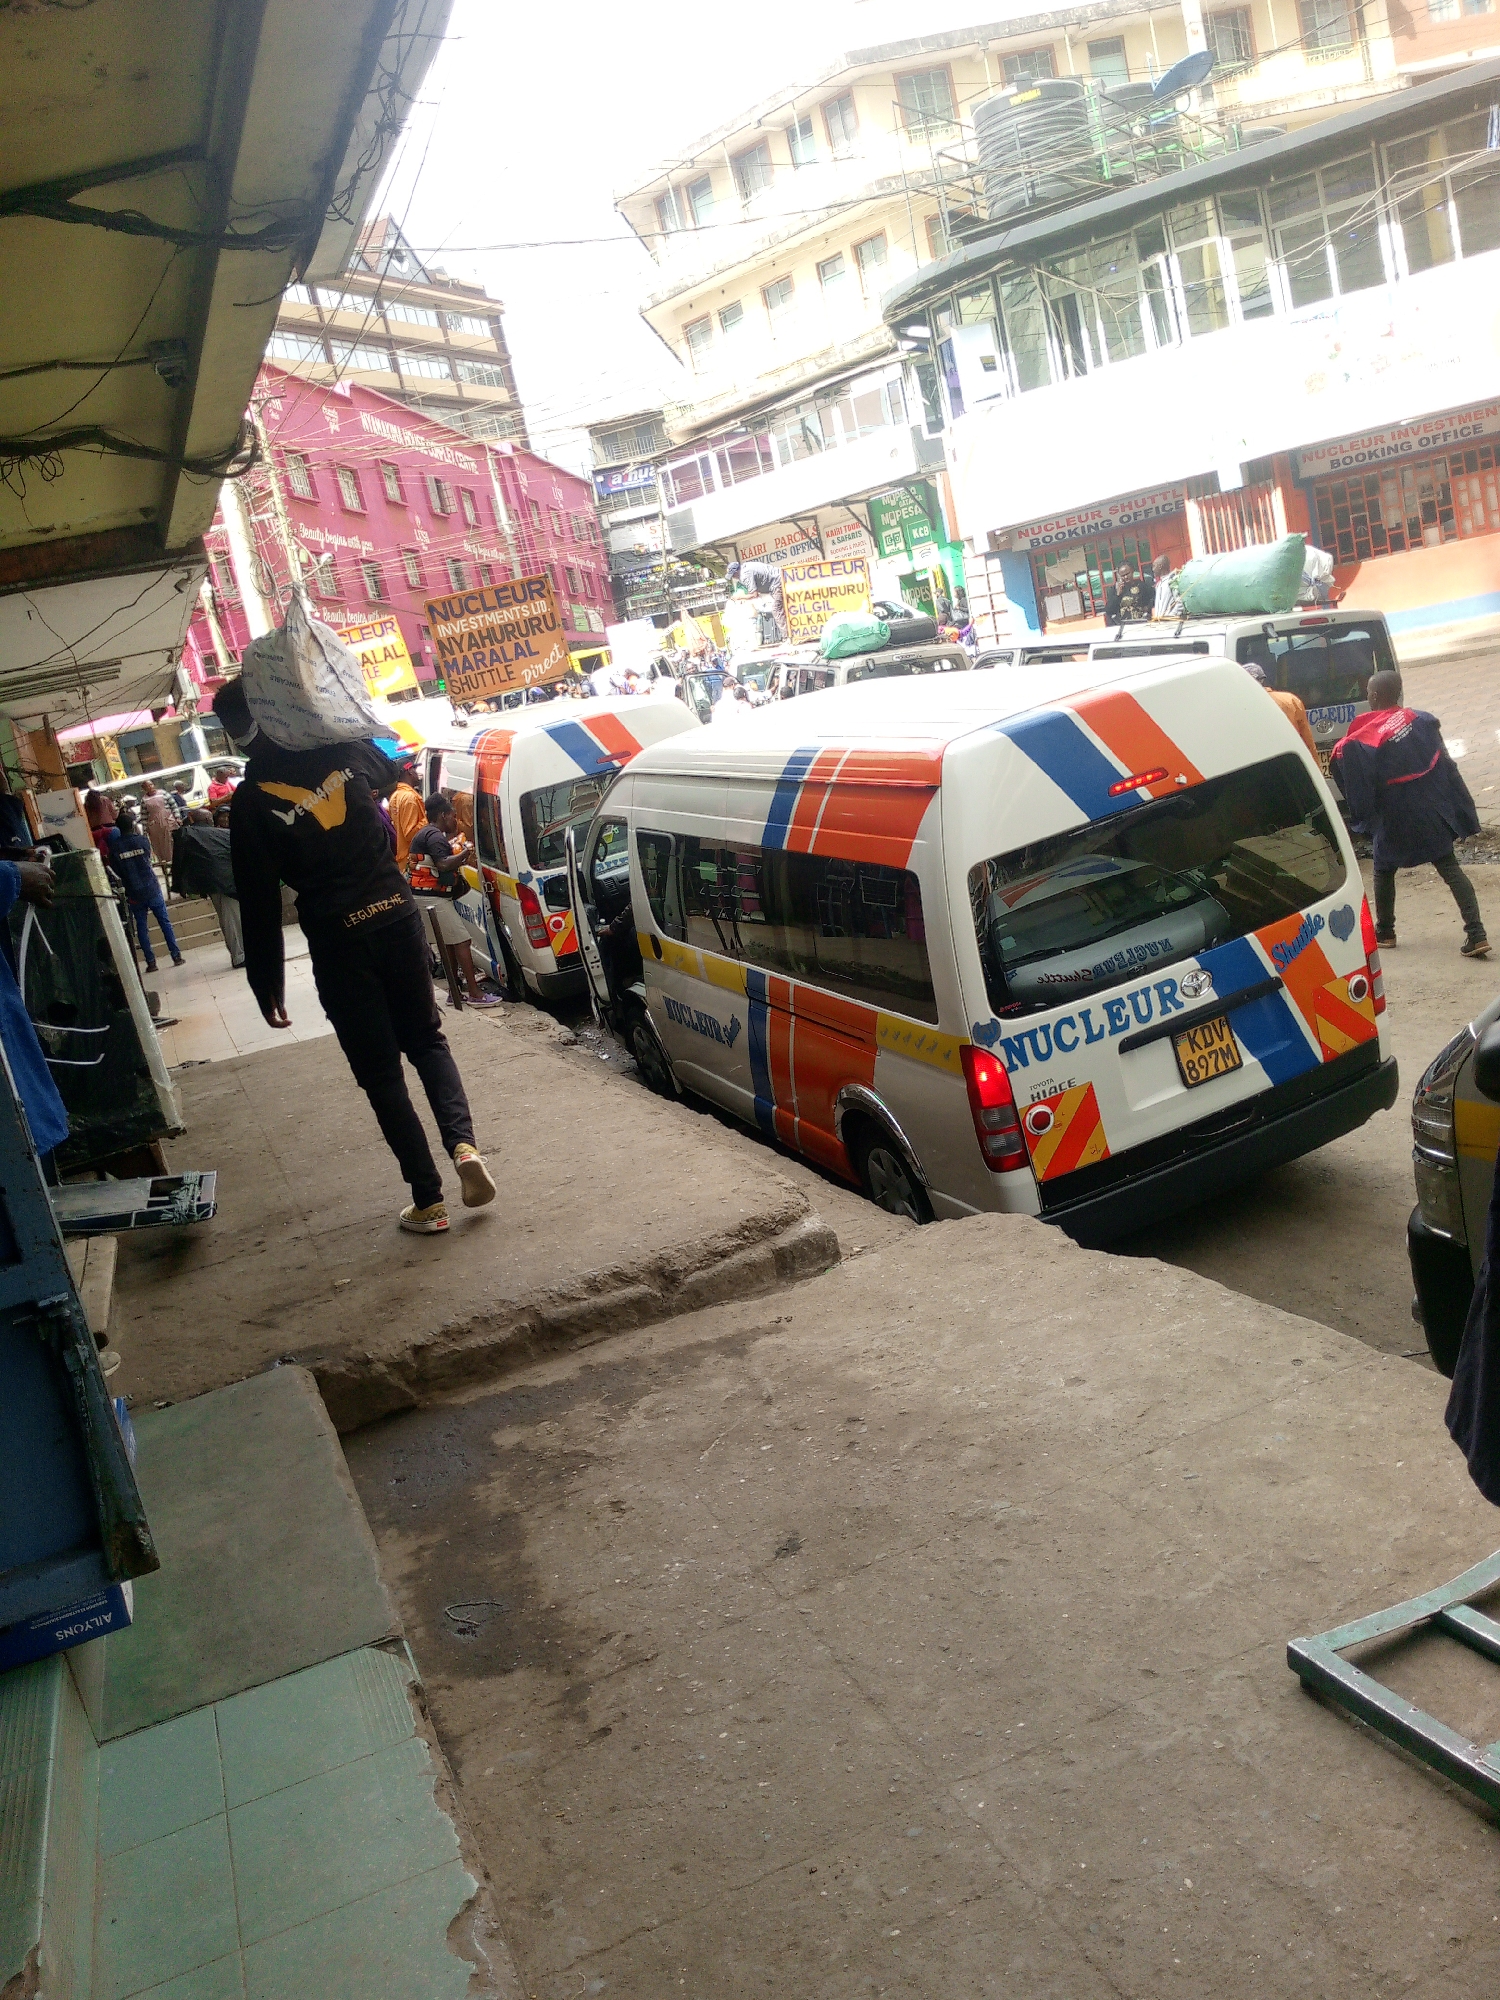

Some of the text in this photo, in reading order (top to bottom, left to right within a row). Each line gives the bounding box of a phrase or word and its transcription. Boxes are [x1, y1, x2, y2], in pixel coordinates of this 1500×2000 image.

[1302, 404, 1500, 464] NUCLEUR INVESTMEN
[1330, 422, 1484, 469] BOOKING OFFICE
[299, 523, 325, 549] Beauty
[325, 528, 347, 551] begins
[837, 531, 862, 544] SAFARIS
[912, 526, 929, 539] KCB
[1017, 510, 1103, 539] NUCLEUR
[1029, 500, 1185, 548] BOOKING OFFICE
[740, 543, 768, 561] KAIRI
[774, 525, 820, 549] PARCELS
[783, 560, 865, 583] NUCLEUR
[427, 580, 546, 625] NUCLEUR
[786, 583, 865, 604] NYAHURURU
[788, 600, 835, 616] GILGIL
[322, 607, 346, 629] Beauty
[436, 612, 557, 659] NYAHURURU
[437, 604, 531, 637] INVESTMENTS
[443, 640, 540, 679] MARALAL
[449, 642, 564, 695] SHUTTLE Direct
[1271, 913, 1325, 973] Shuttle
[663, 996, 724, 1042] NUCLEUR
[999, 978, 1185, 1074] NUCLEUR
[1186, 1019, 1225, 1054] KDV
[1186, 1043, 1237, 1082] 897M
[1029, 1078, 1054, 1091] TOYOTA
[1030, 1077, 1077, 1103] HIACE
[56, 1611, 112, 1641] AILYONS
